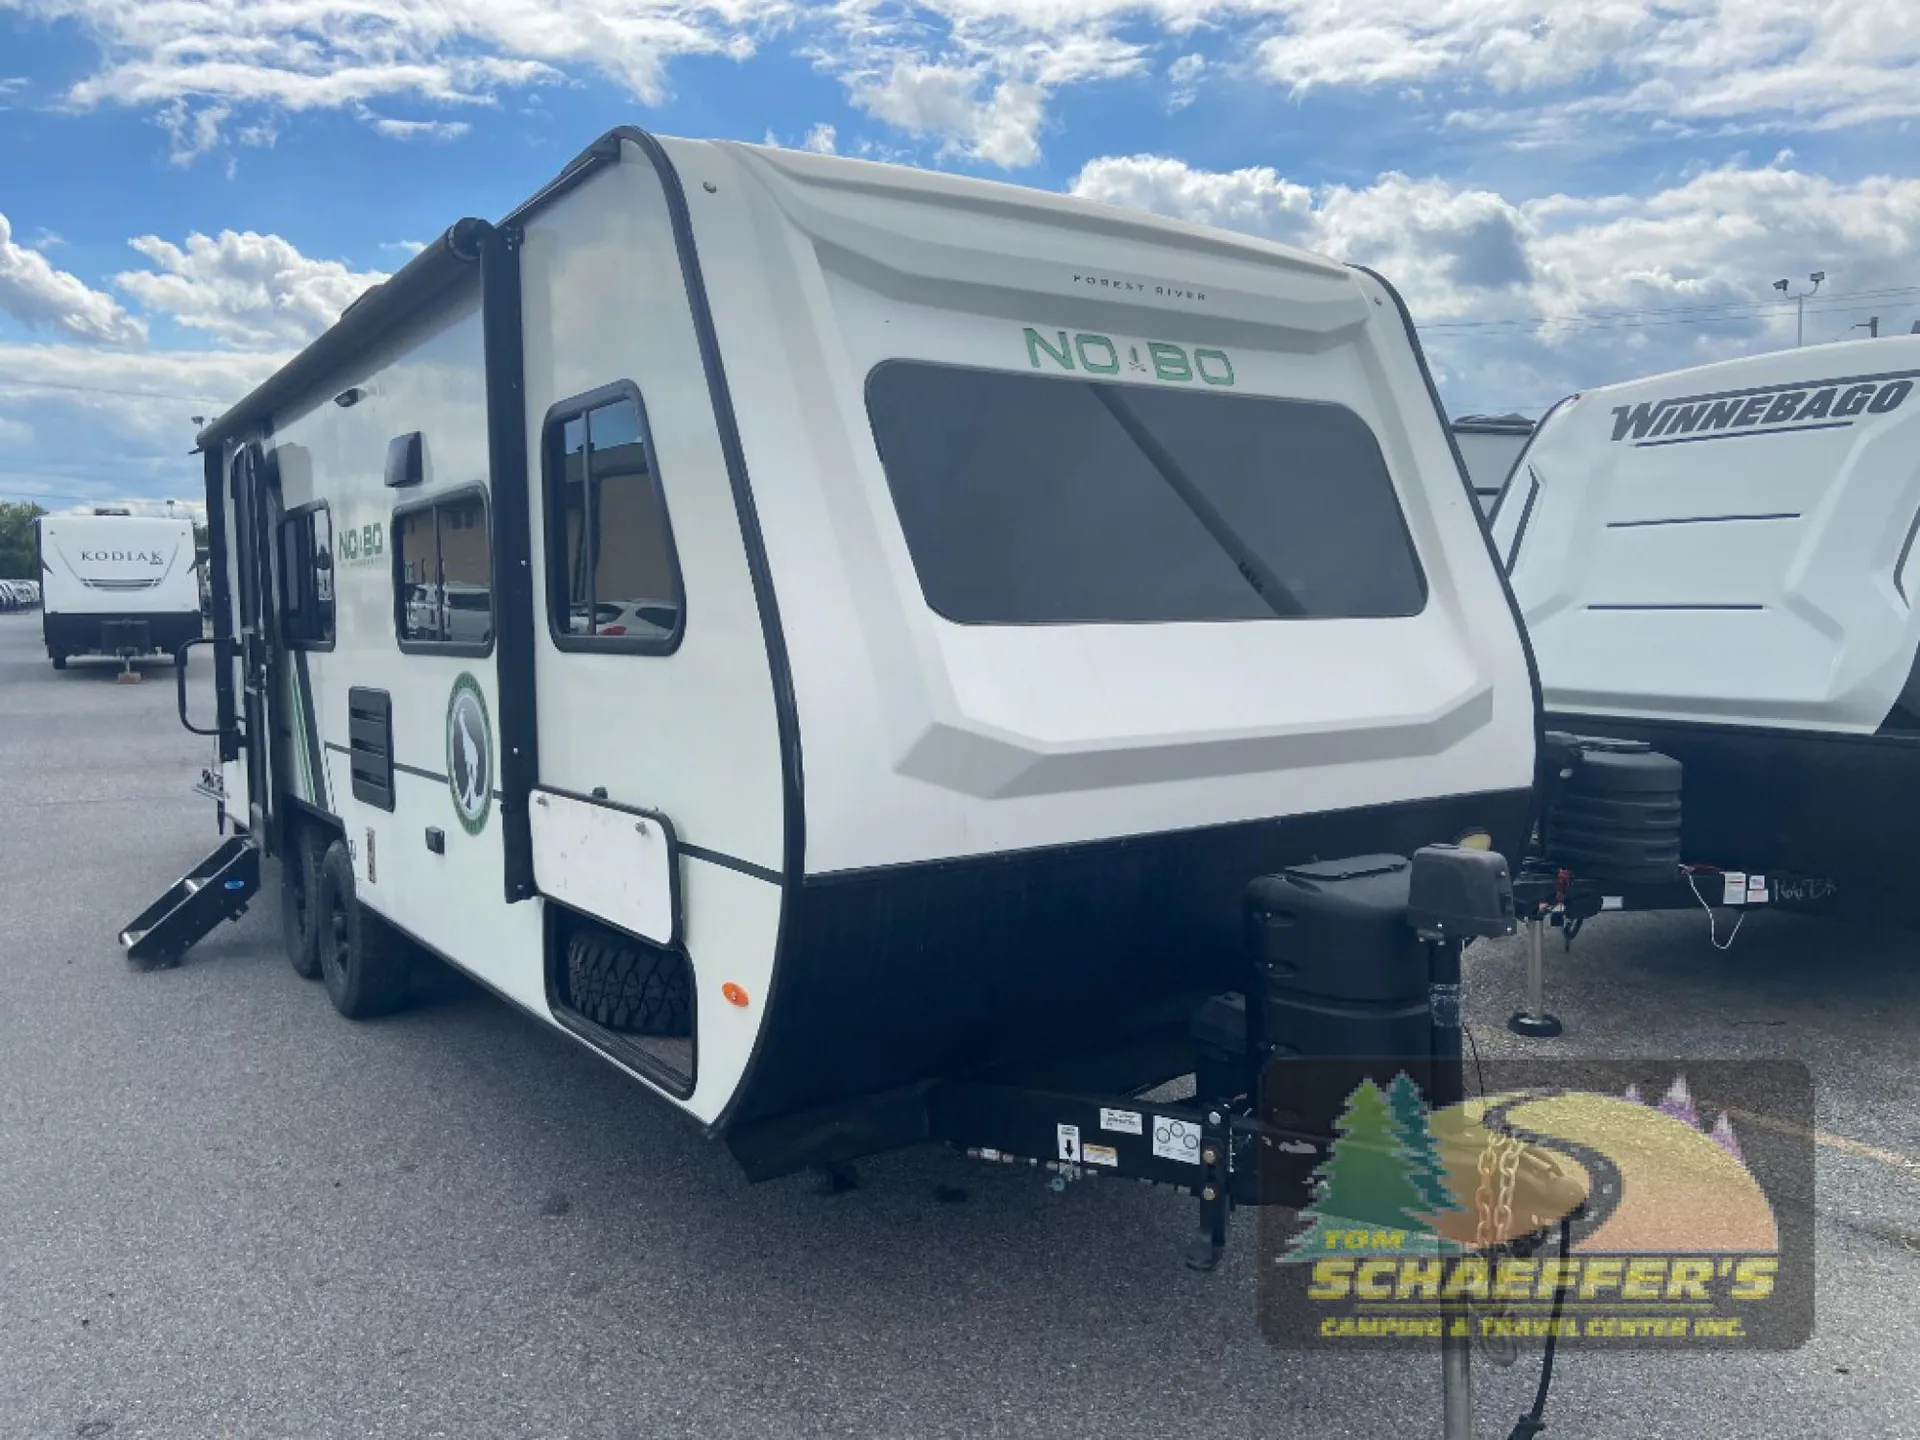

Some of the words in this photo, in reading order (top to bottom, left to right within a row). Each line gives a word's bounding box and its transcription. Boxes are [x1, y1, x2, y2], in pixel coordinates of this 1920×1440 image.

[1073, 274, 1145, 292] FOREST
[1155, 285, 1206, 301] RIVER
[1610, 379, 1914, 442] WINNEBAGO
[81, 551, 162, 562] KODIAK
